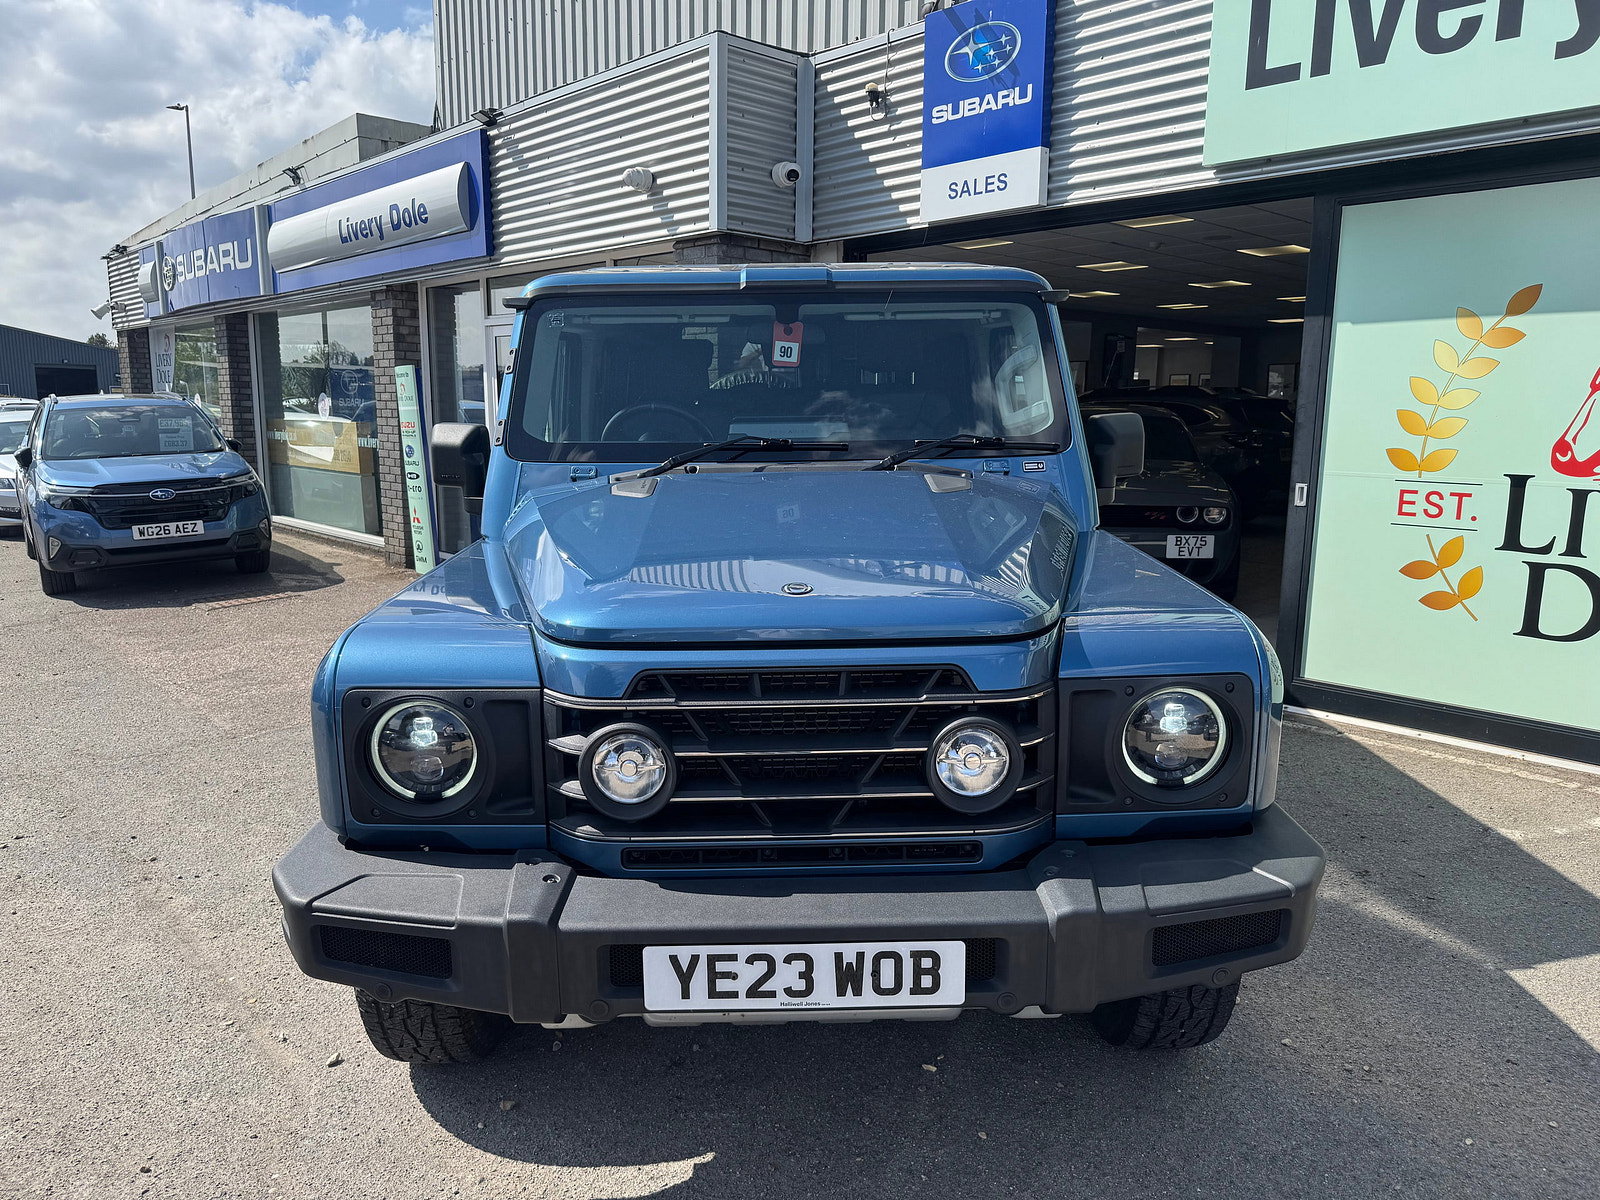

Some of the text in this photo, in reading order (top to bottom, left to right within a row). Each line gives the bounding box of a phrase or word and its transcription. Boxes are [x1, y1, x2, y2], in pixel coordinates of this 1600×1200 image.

[931, 83, 1033, 125] SUBARU
[947, 172, 1009, 200] SALES
[338, 198, 429, 244] Livery Dole
[175, 238, 253, 283] SUBARU
[154, 352, 172, 367] LIVERY
[779, 345, 793, 358] 90
[156, 368, 172, 384] DOLE
[1396, 489, 1478, 522] EST.
[1494, 473, 1600, 559] LI
[137, 521, 199, 538] WG26 AEZ
[1174, 535, 1208, 547] BX75
[1177, 546, 1203, 557] EVT
[668, 949, 942, 999] YE23 WOB
